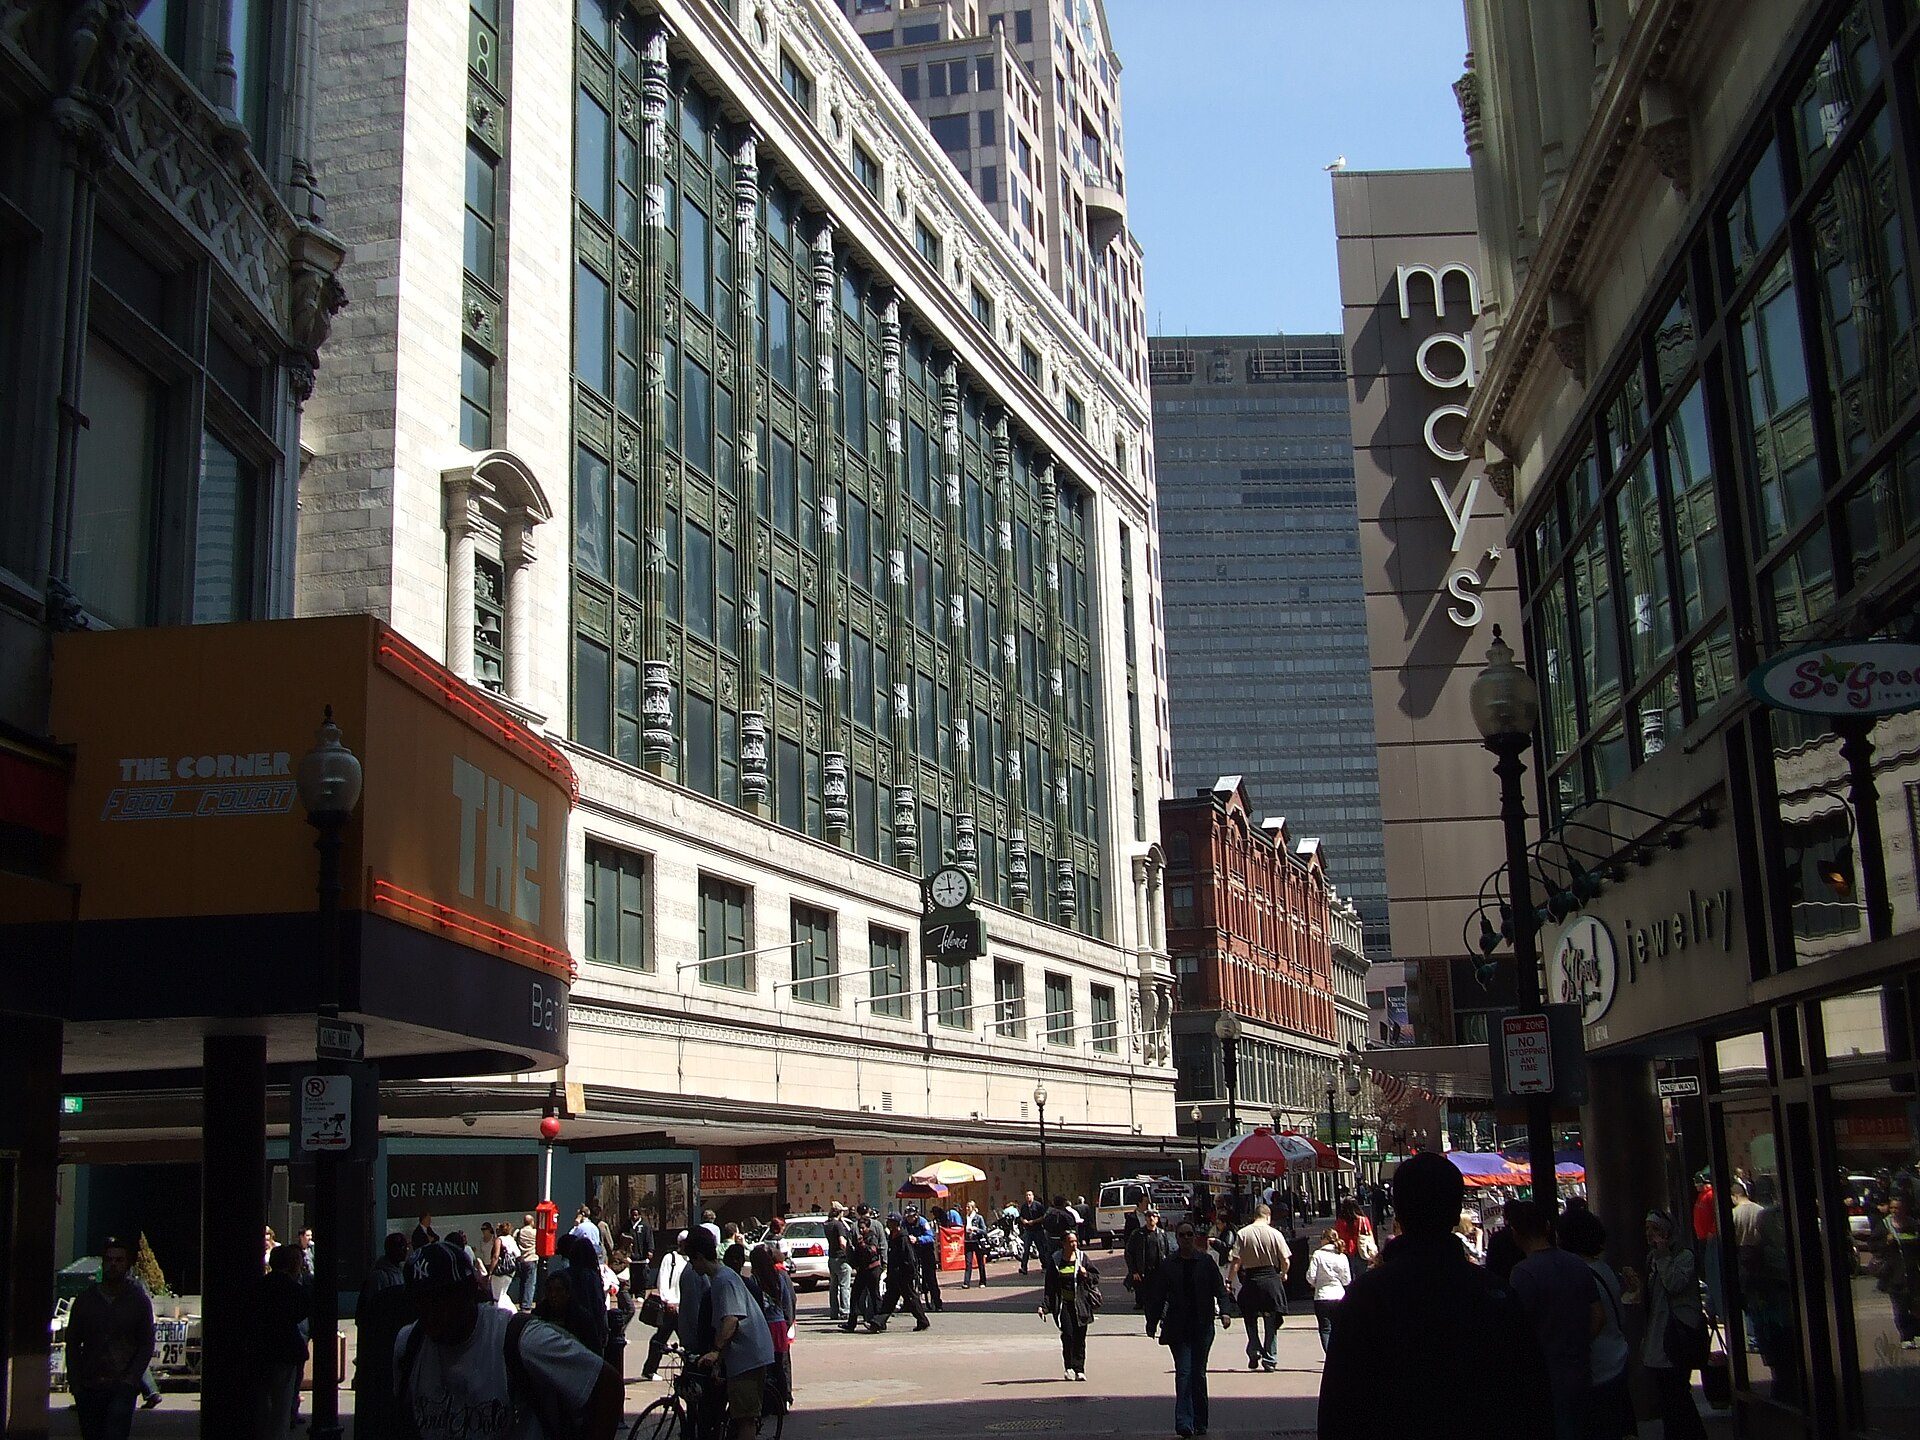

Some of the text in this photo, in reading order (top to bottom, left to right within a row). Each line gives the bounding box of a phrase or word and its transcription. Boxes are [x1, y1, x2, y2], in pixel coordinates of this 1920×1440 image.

[1789, 660, 1838, 699] So
[119, 752, 291, 781] THE CORNER
[452, 754, 541, 926] THE
[1625, 889, 1732, 984] jewelry
[1505, 1020, 1546, 1032] TOW ZONE
[322, 1029, 351, 1046] ONE WAY
[1518, 1036, 1535, 1047] NO
[1509, 1047, 1546, 1057] STOPPING
[1521, 1056, 1535, 1064] ANY
[1520, 1063, 1539, 1072] TIME
[1661, 1082, 1695, 1092] ONE WAY
[700, 1163, 778, 1180] FILENE'S BASEMENT
[390, 1180, 479, 1198] ONE FRANKLIN
[154, 1324, 186, 1342] erald
